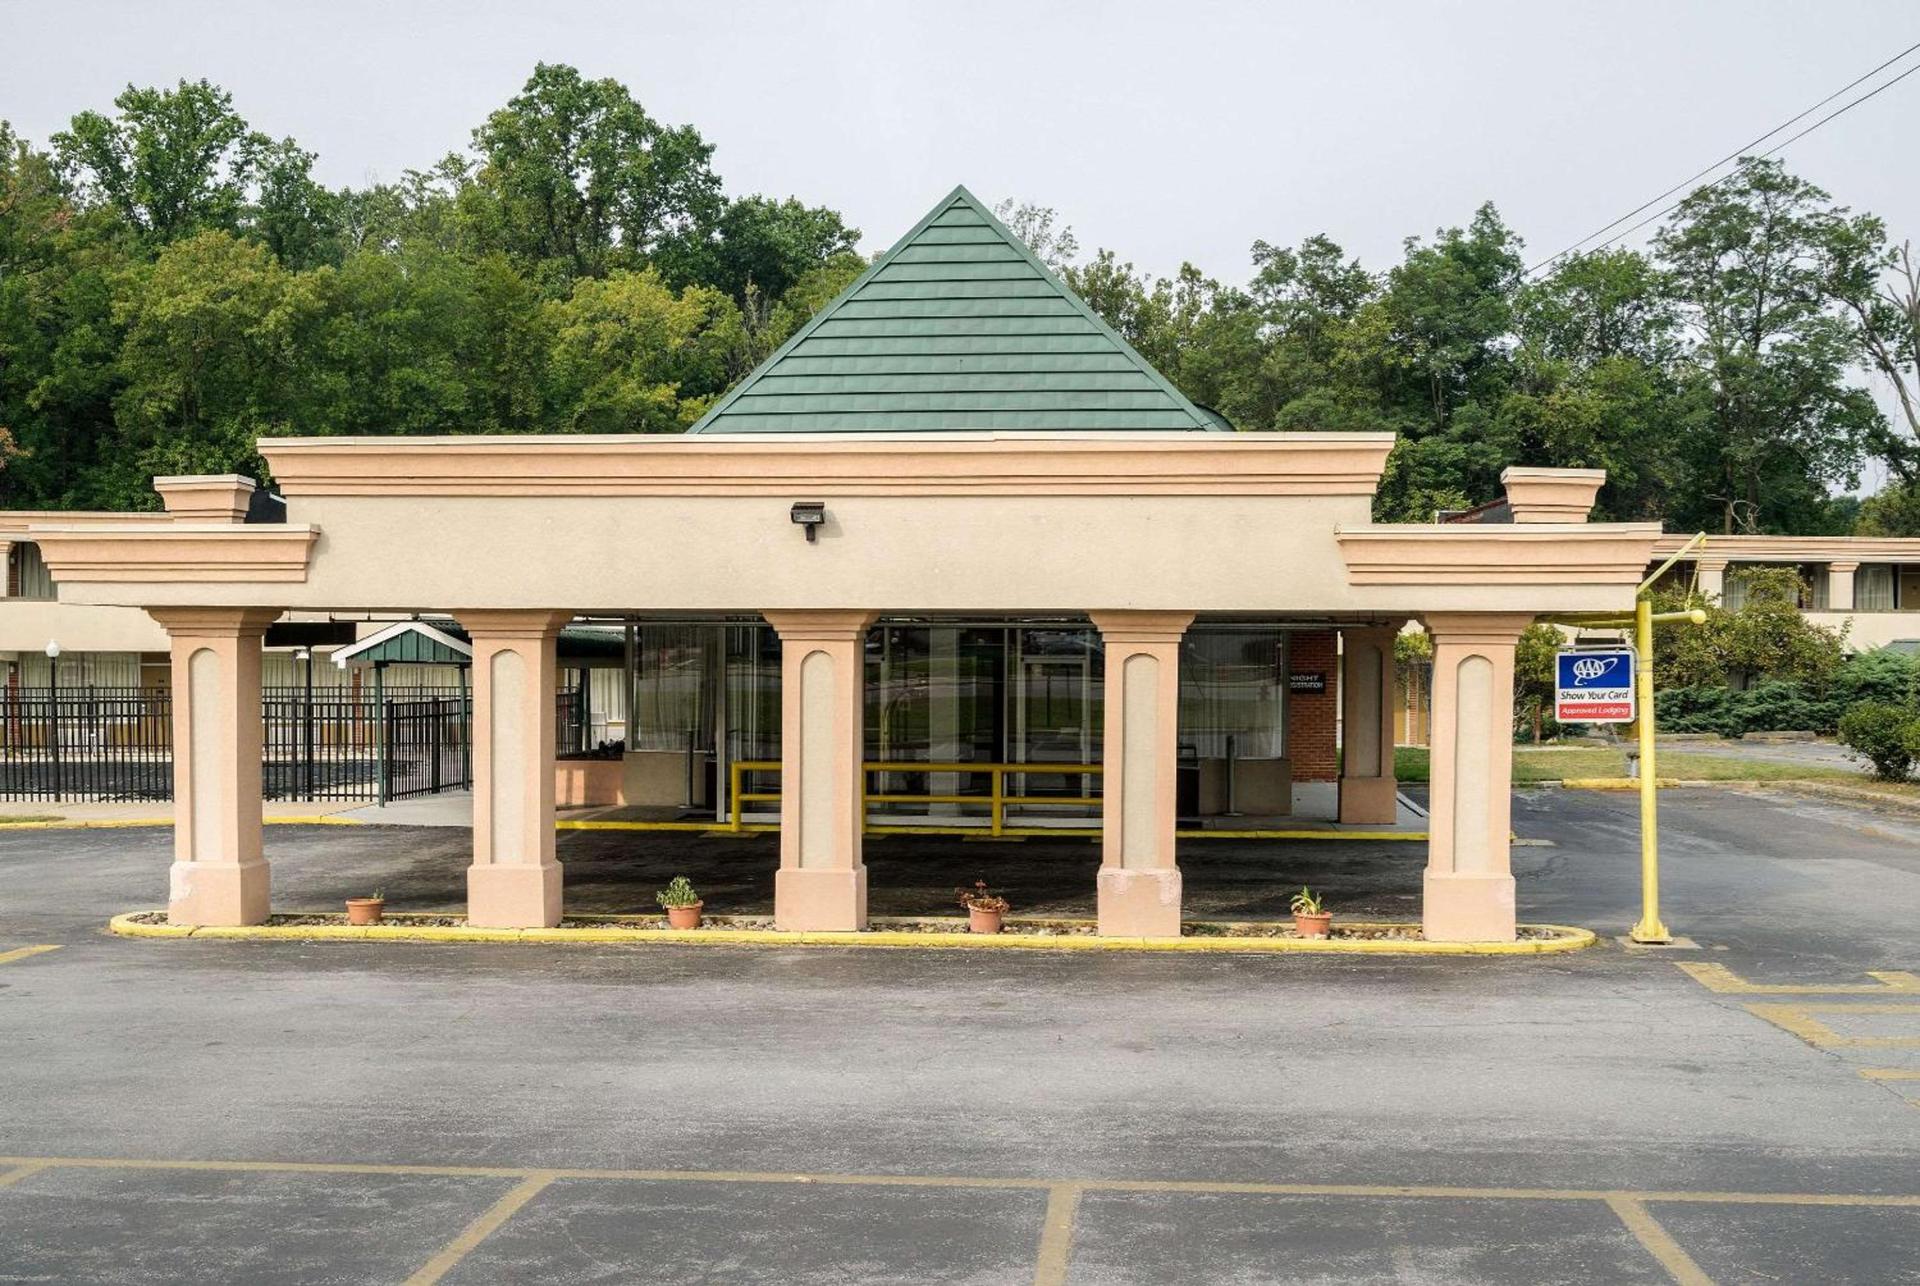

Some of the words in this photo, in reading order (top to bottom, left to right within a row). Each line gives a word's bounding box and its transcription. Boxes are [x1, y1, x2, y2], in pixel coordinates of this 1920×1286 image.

[1576, 660, 1600, 679] AAA
[1560, 690, 1586, 700] Show
[1588, 690, 1606, 700] Your
[1608, 690, 1629, 700] Card
[1561, 706, 1597, 715] Approved
[1599, 706, 1629, 715] Lodging
